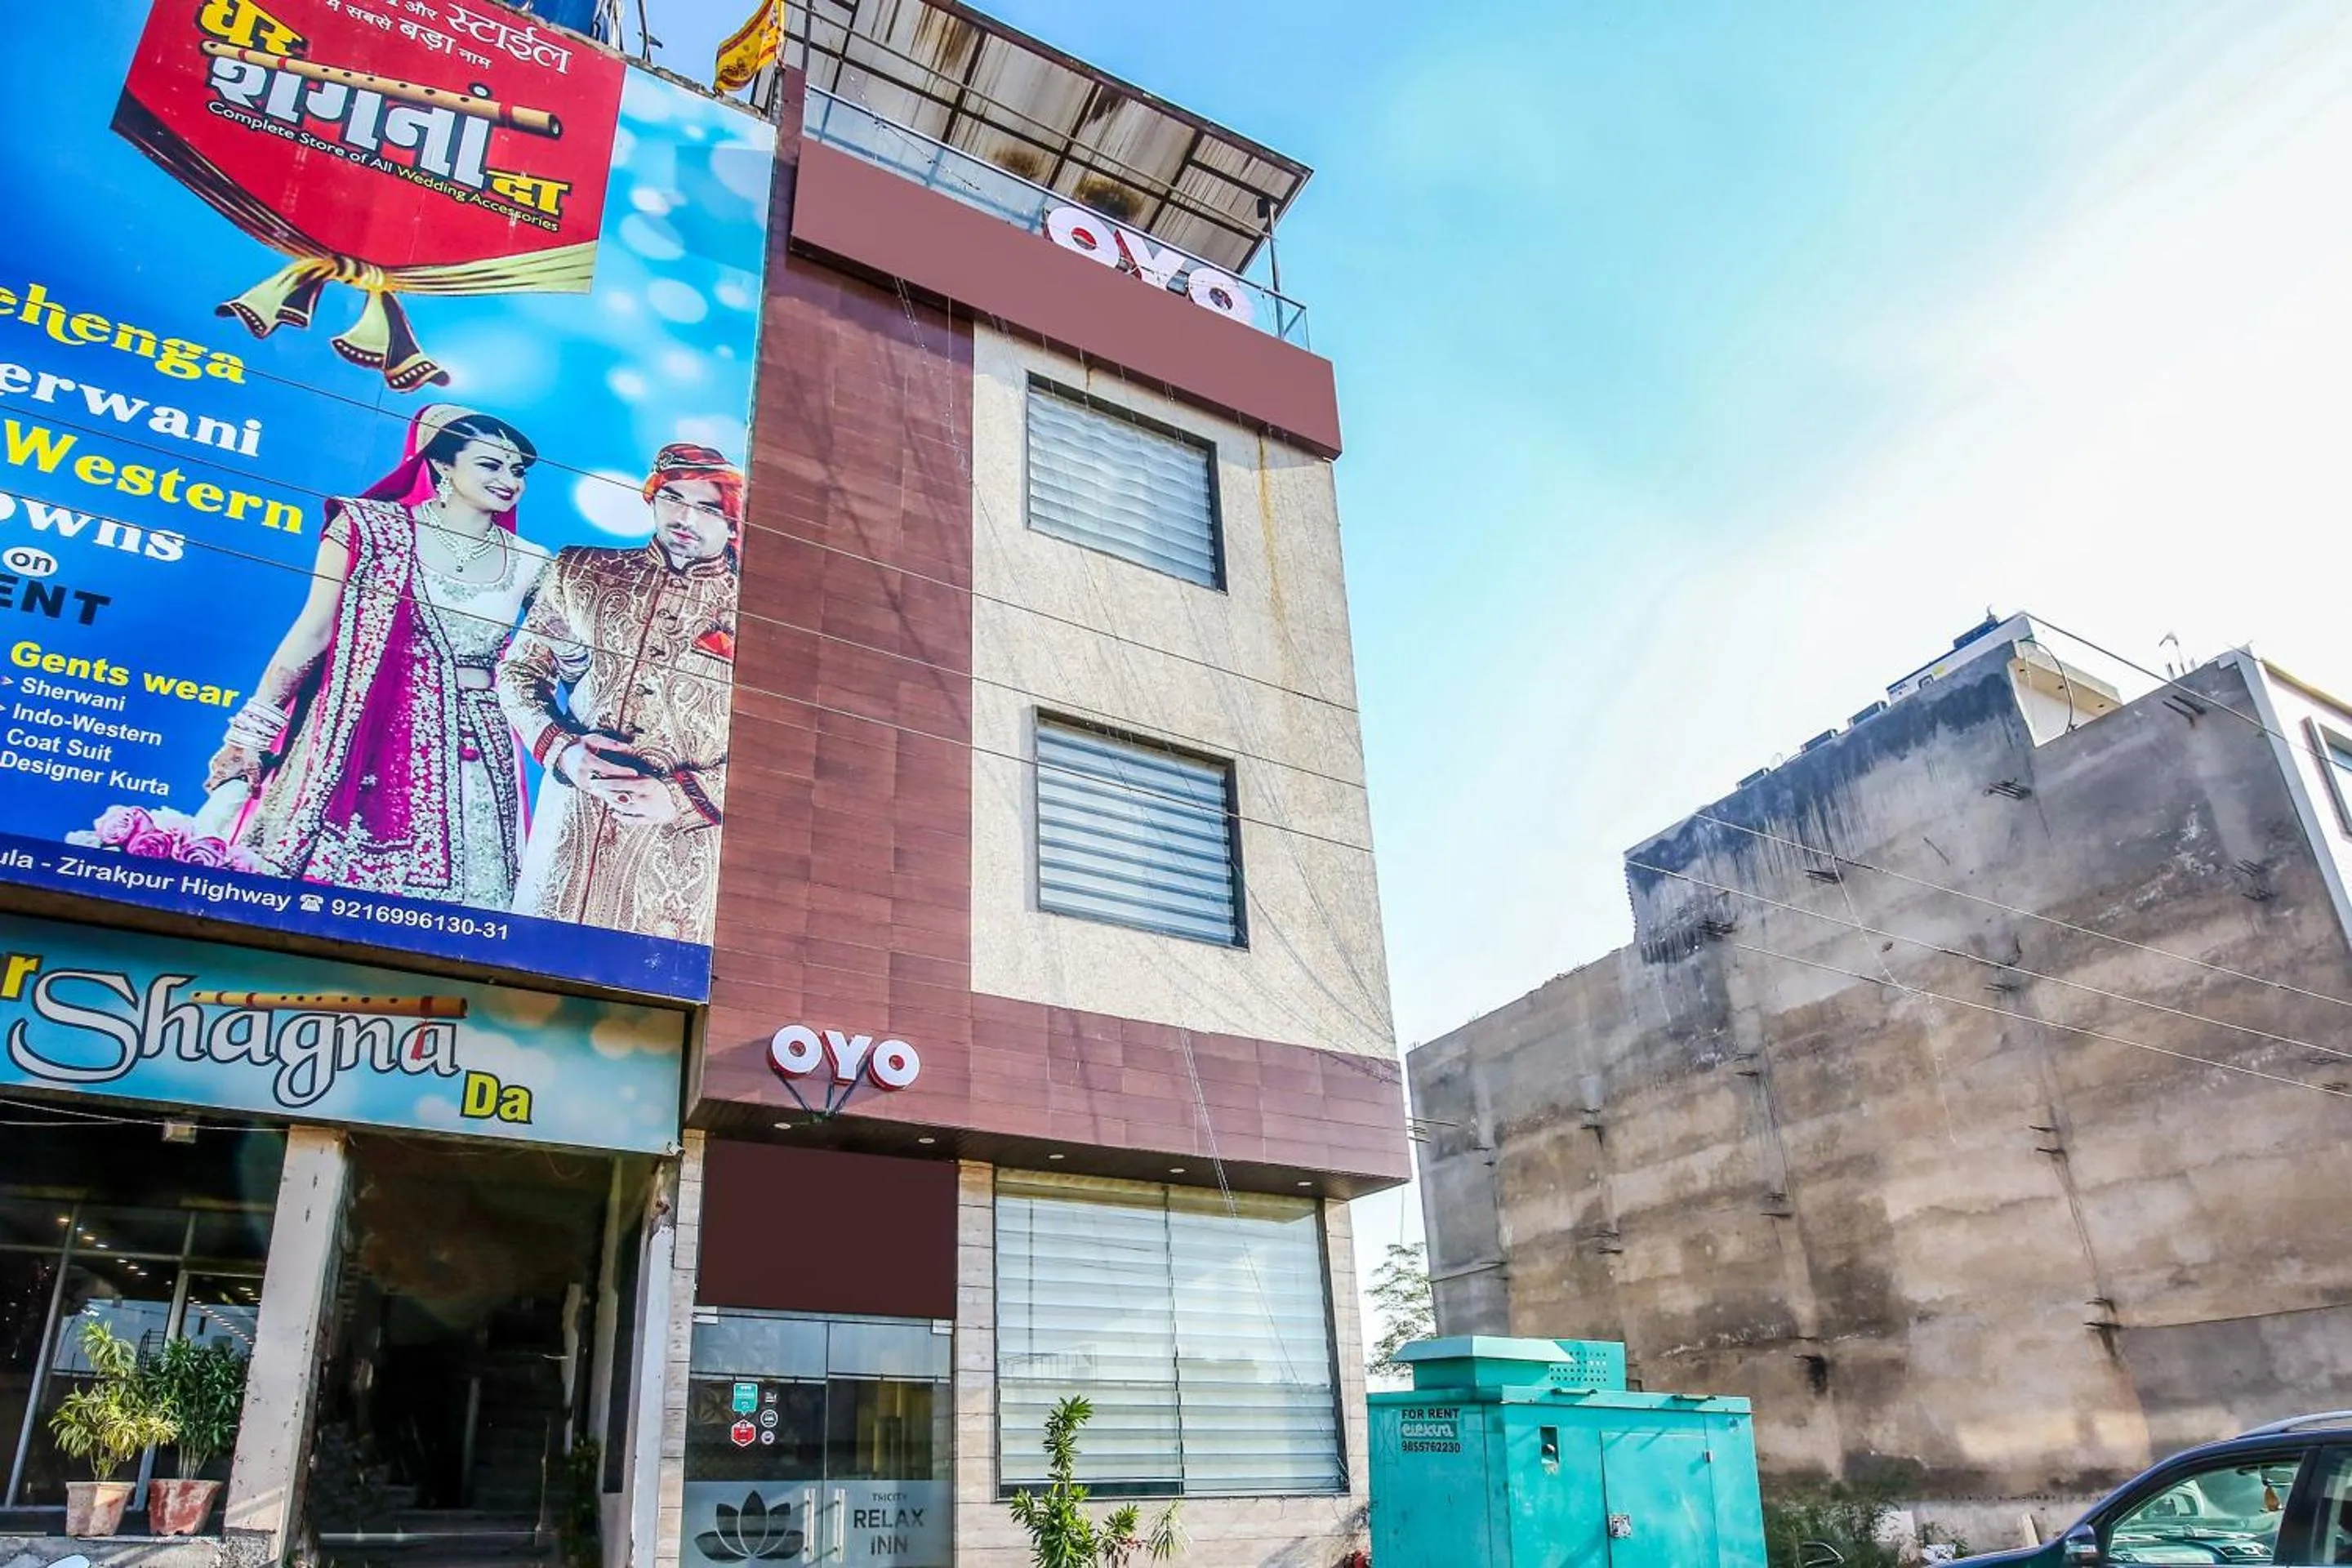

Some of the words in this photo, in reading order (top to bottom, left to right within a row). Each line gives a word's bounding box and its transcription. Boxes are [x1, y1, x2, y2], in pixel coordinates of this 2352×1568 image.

[398, 17, 457, 54] बड़ा
[457, 47, 492, 69] नाम
[446, 5, 573, 74] स्टाईल
[207, 100, 296, 140] Complete
[298, 132, 345, 157] Store
[350, 152, 368, 163] of
[370, 158, 394, 173] All
[397, 165, 466, 203] Wedding
[470, 193, 559, 232] Accessories
[1045, 205, 1256, 325] OYO
[4, 417, 303, 535] Western
[11, 552, 53, 572] on
[11, 640, 131, 687] Gents
[143, 670, 241, 709] wear
[20, 676, 127, 712] Sherwani
[7, 728, 62, 754] Coat
[66, 738, 113, 763] Suit
[12, 702, 163, 746] Indo-Western
[0, 750, 105, 784] Designer
[109, 769, 170, 796] Kurta
[56, 856, 174, 890] Zirakpur
[180, 875, 292, 912] Highway
[331, 898, 510, 941] 9216996130-31
[7, 967, 461, 1109] Shagna
[461, 1069, 532, 1125] Da
[768, 1024, 921, 1091] OYO
[1401, 1409, 1425, 1419] FOR
[1428, 1407, 1460, 1419] RENT
[853, 1507, 924, 1529] RELAX
[871, 1535, 908, 1556] INN
